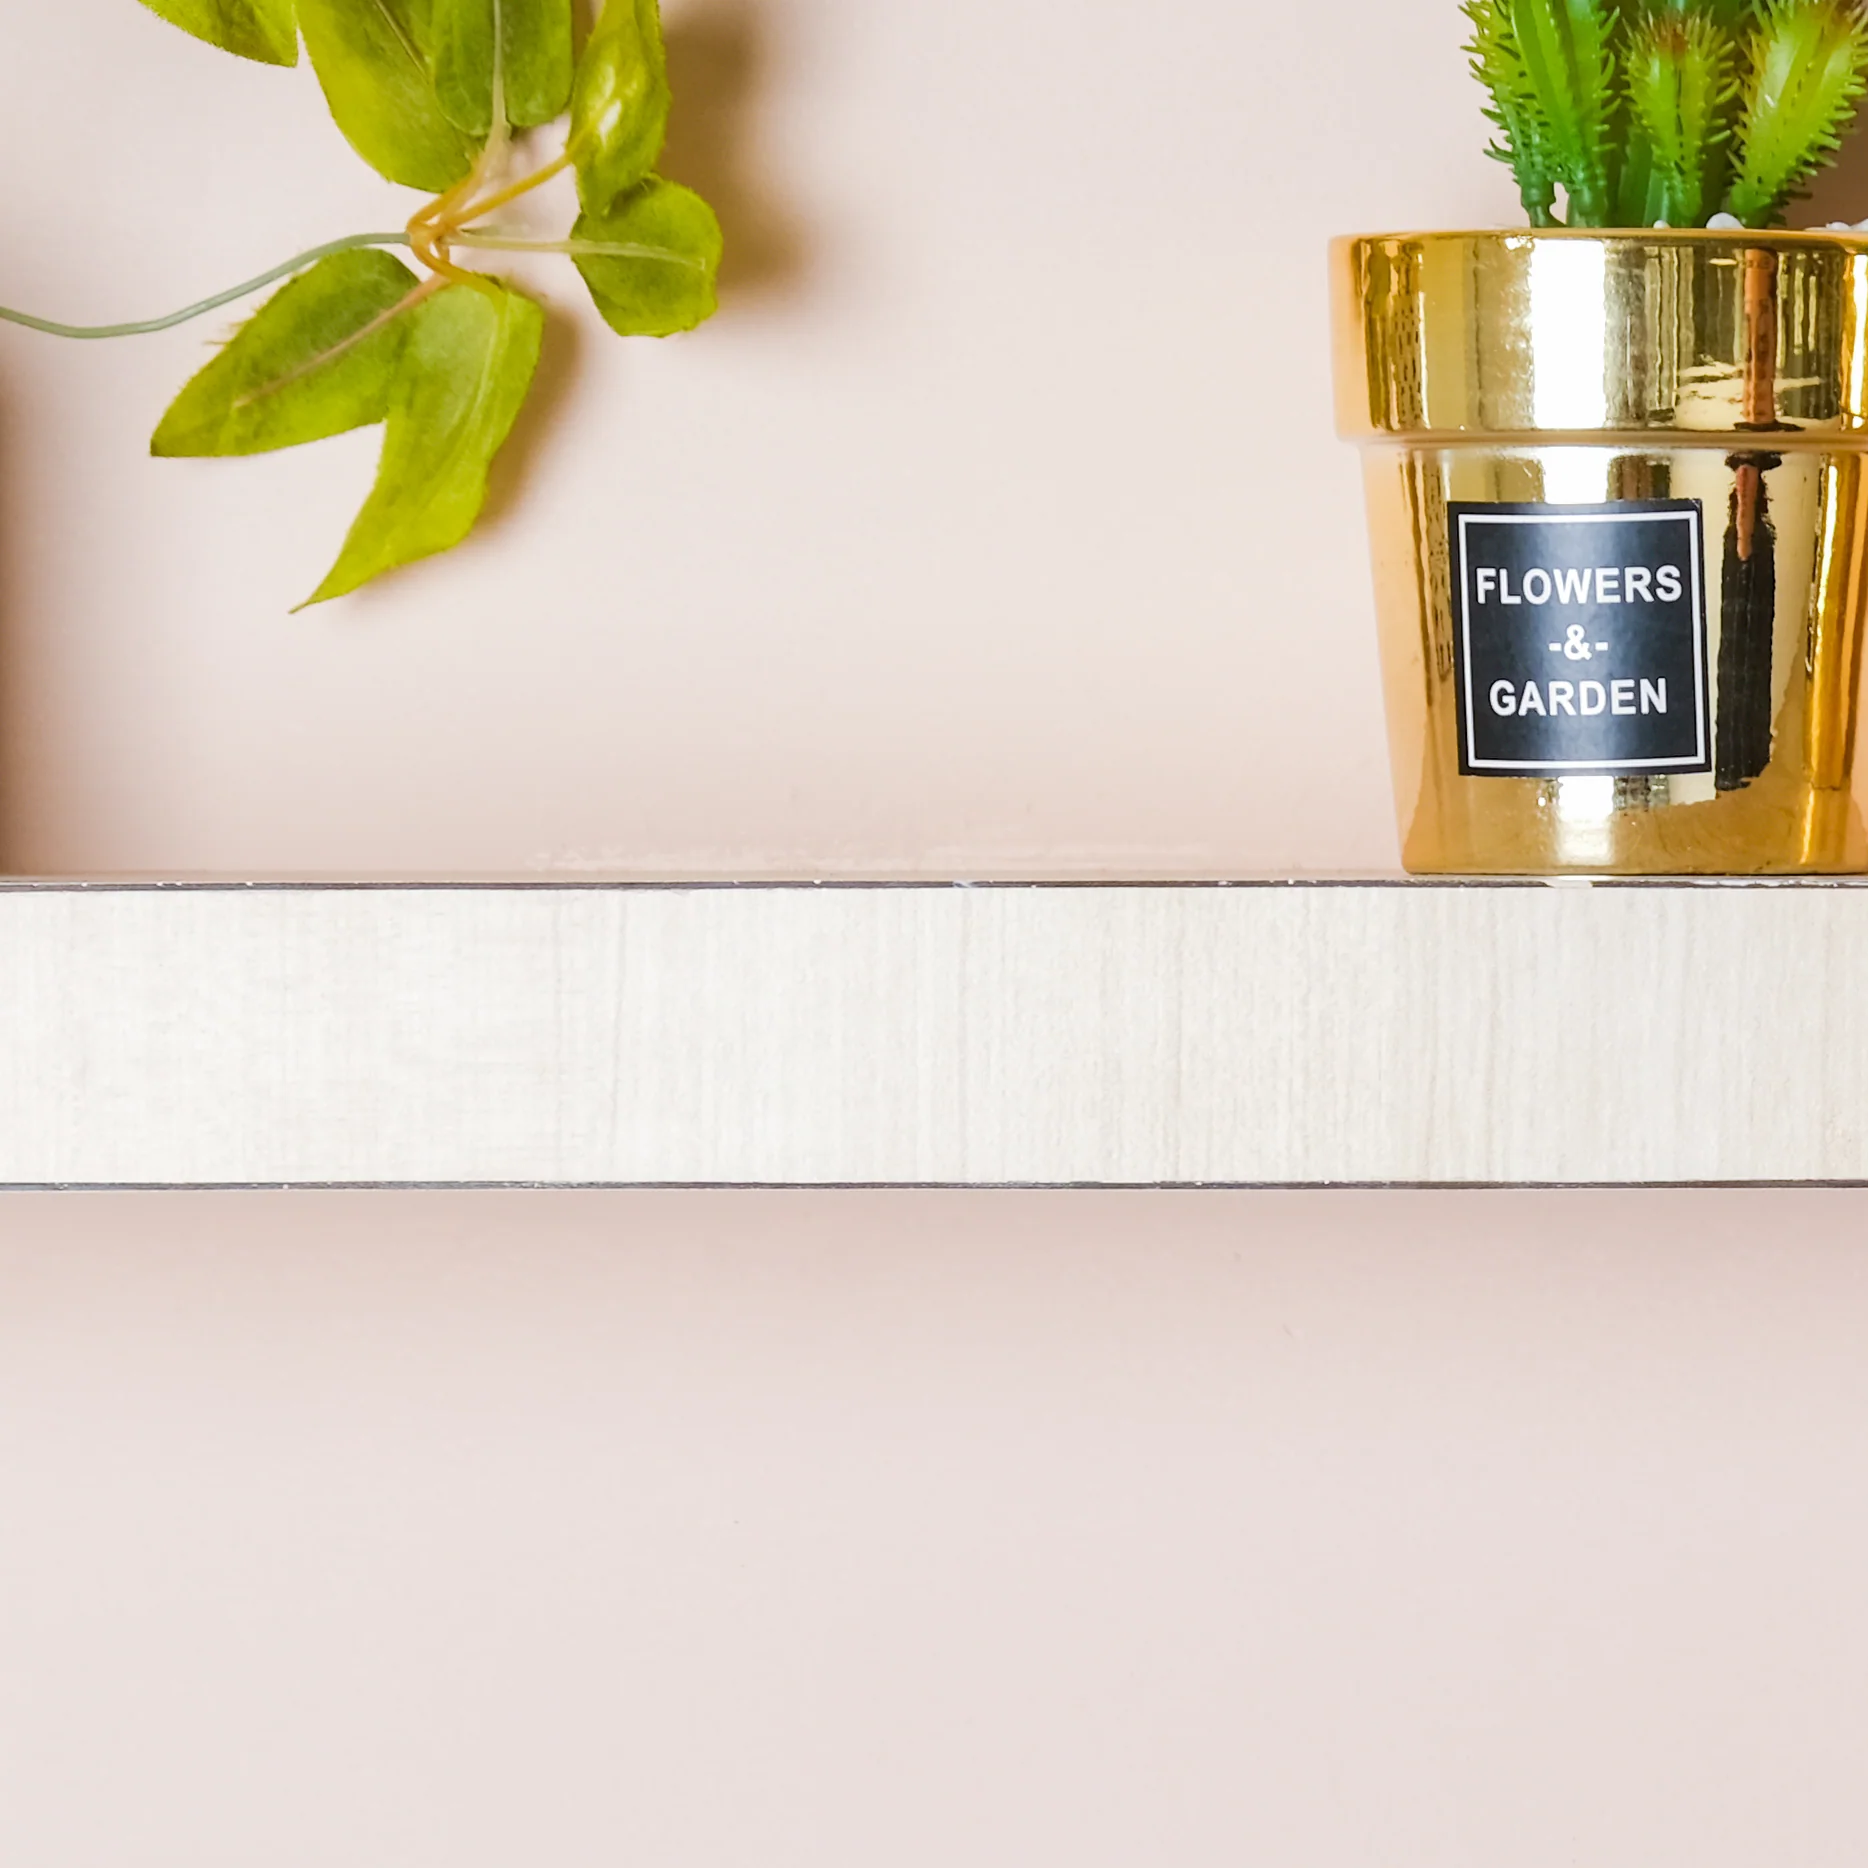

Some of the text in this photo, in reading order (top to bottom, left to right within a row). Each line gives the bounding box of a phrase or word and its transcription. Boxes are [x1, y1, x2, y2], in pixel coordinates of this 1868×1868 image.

[1475, 564, 1683, 605] FLOWERS
[1548, 623, 1609, 661] -&-
[1488, 676, 1668, 717] GARDEN
